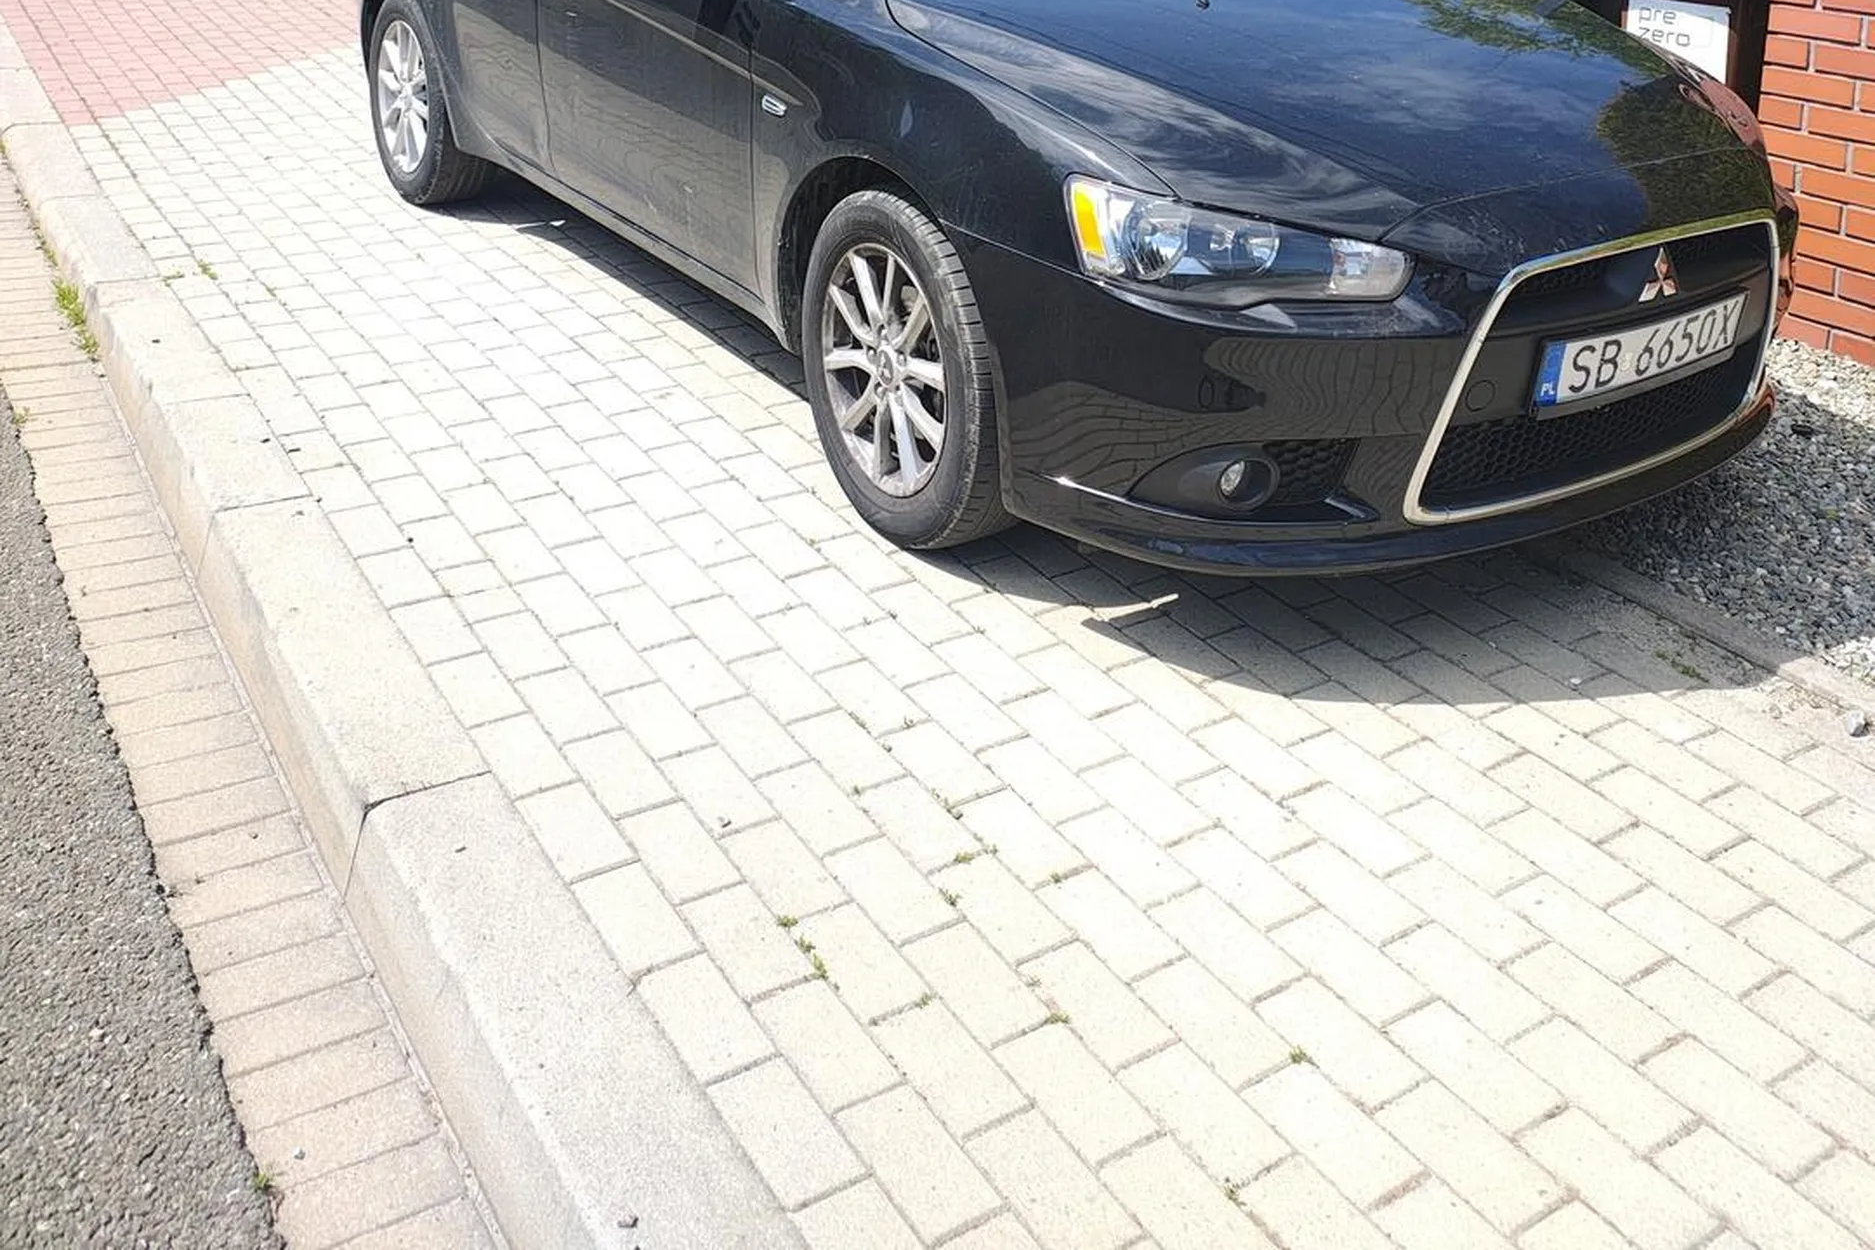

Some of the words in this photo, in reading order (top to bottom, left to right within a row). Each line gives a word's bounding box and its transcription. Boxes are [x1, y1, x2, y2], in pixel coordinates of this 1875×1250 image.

[1638, 6, 1677, 25] pre
[1638, 26, 1690, 47] zero
[1568, 339, 1622, 393] SB
[1635, 303, 1738, 377] 6650X
[1540, 382, 1556, 396] PL
